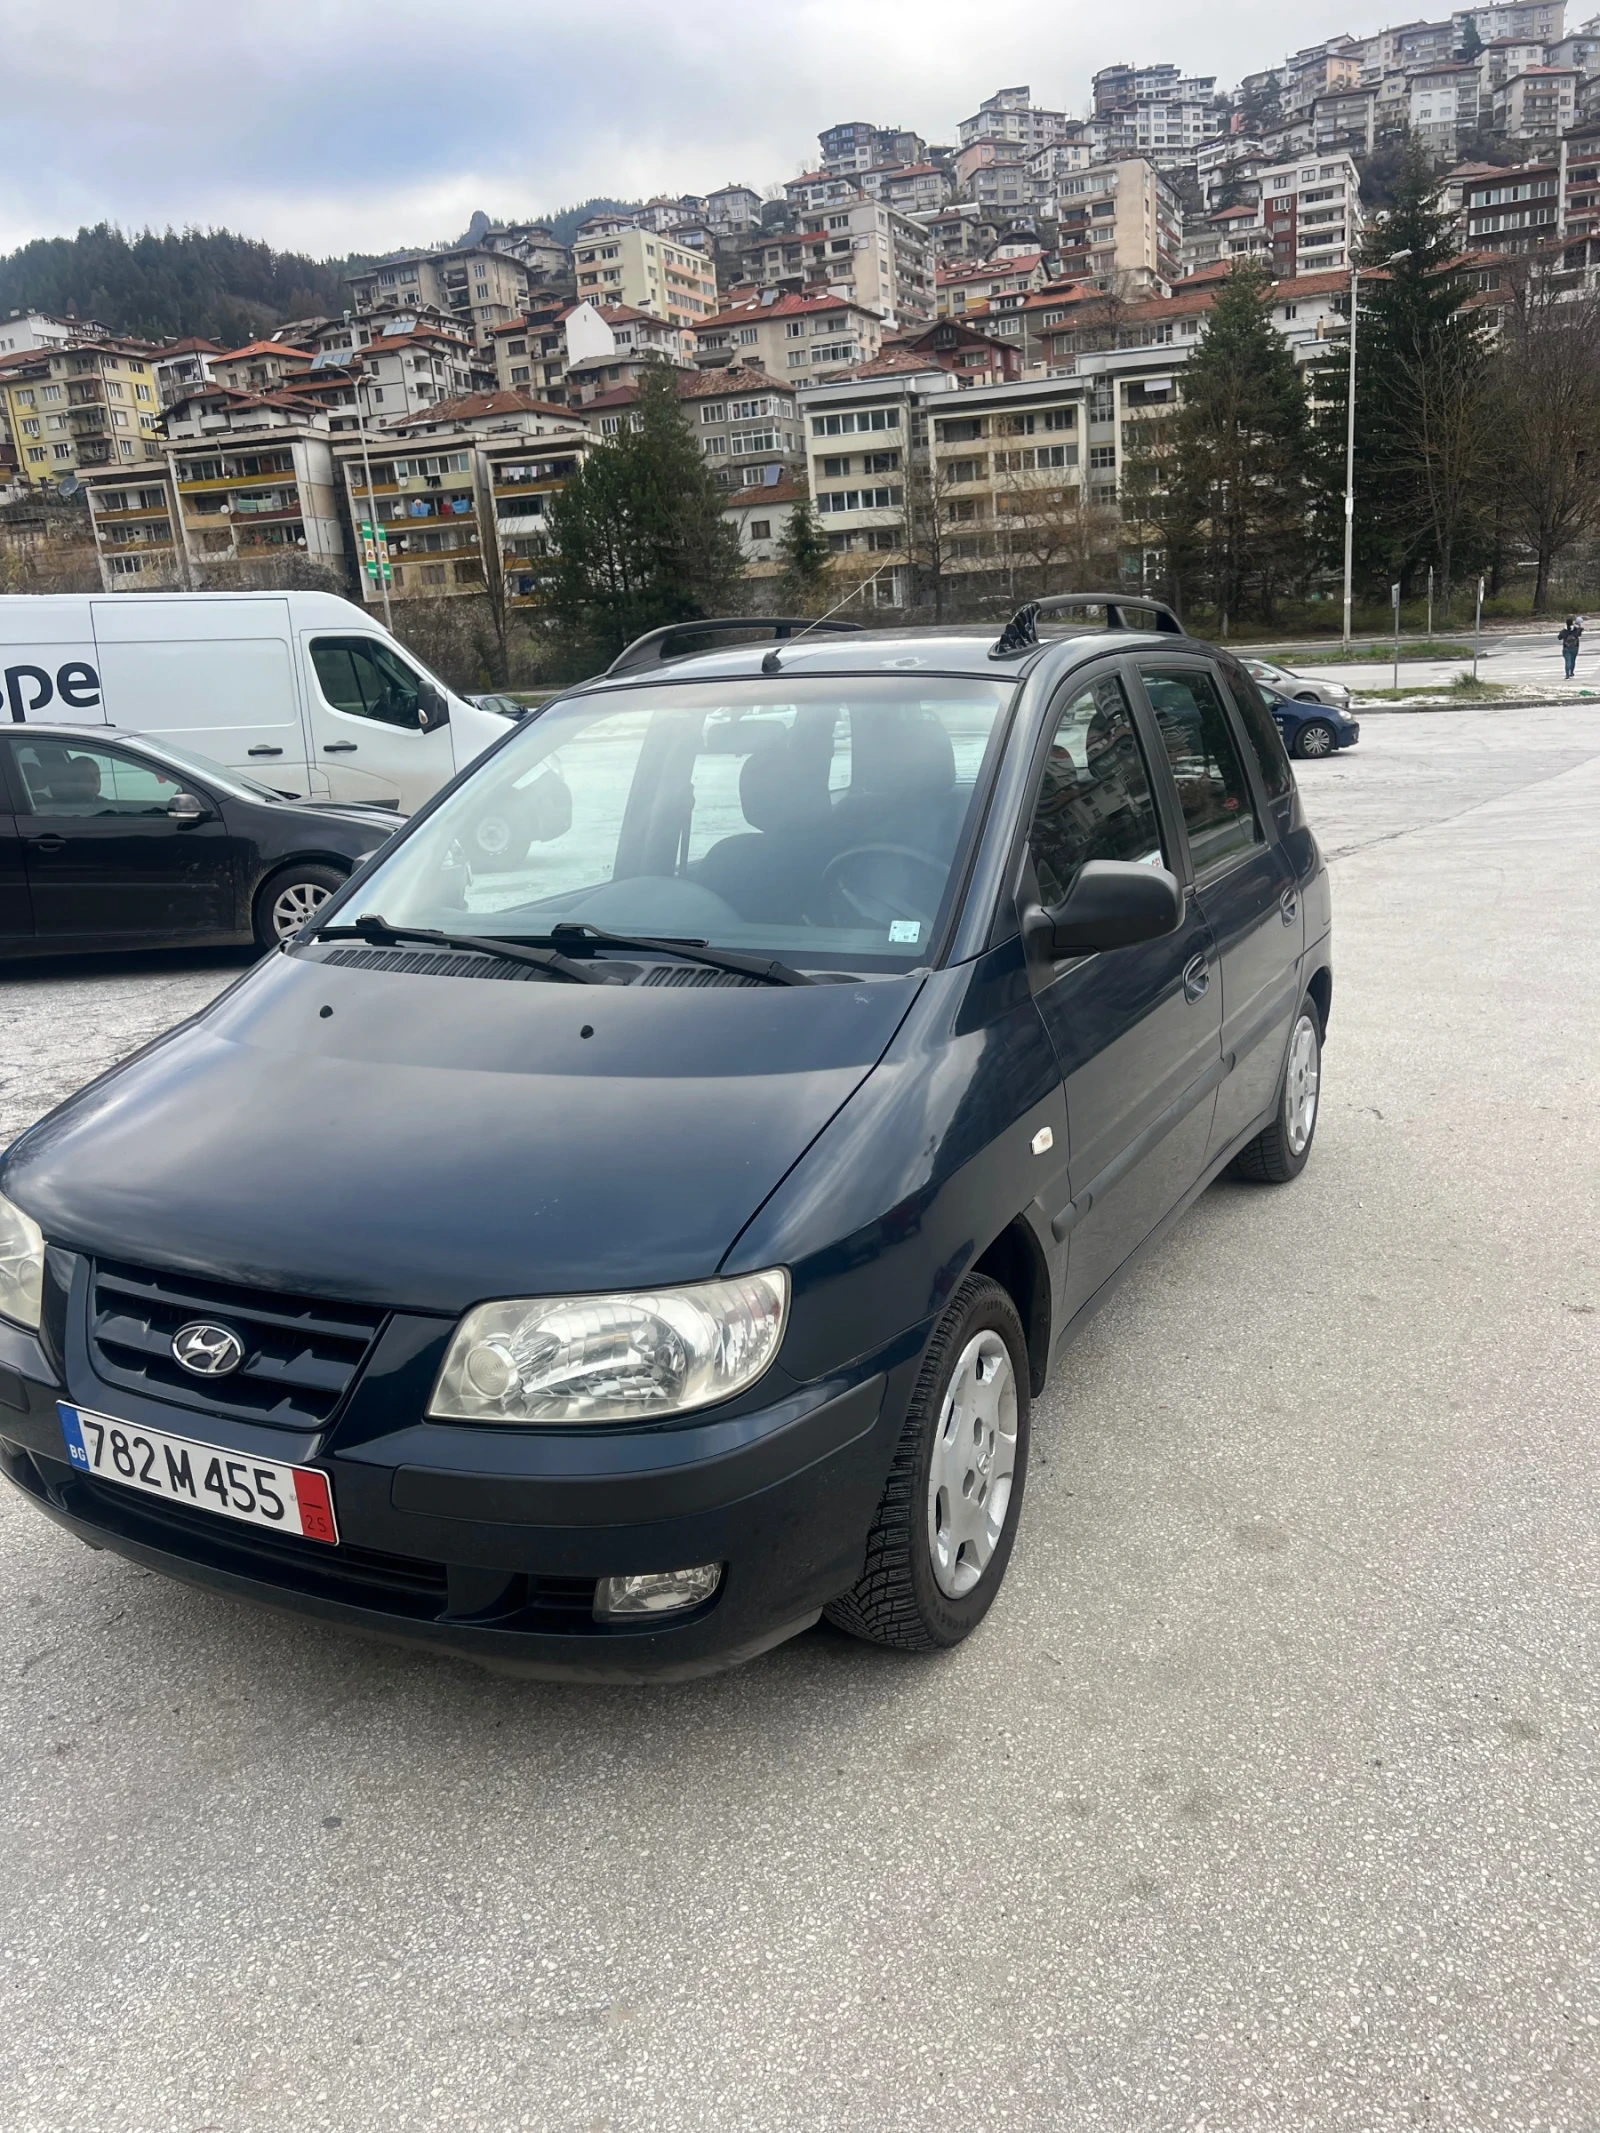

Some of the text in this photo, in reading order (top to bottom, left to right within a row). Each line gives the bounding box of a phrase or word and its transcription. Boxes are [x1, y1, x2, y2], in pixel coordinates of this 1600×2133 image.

[0, 661, 100, 722] pe
[69, 1443, 87, 1462] BG
[305, 1514, 327, 1533] 25
